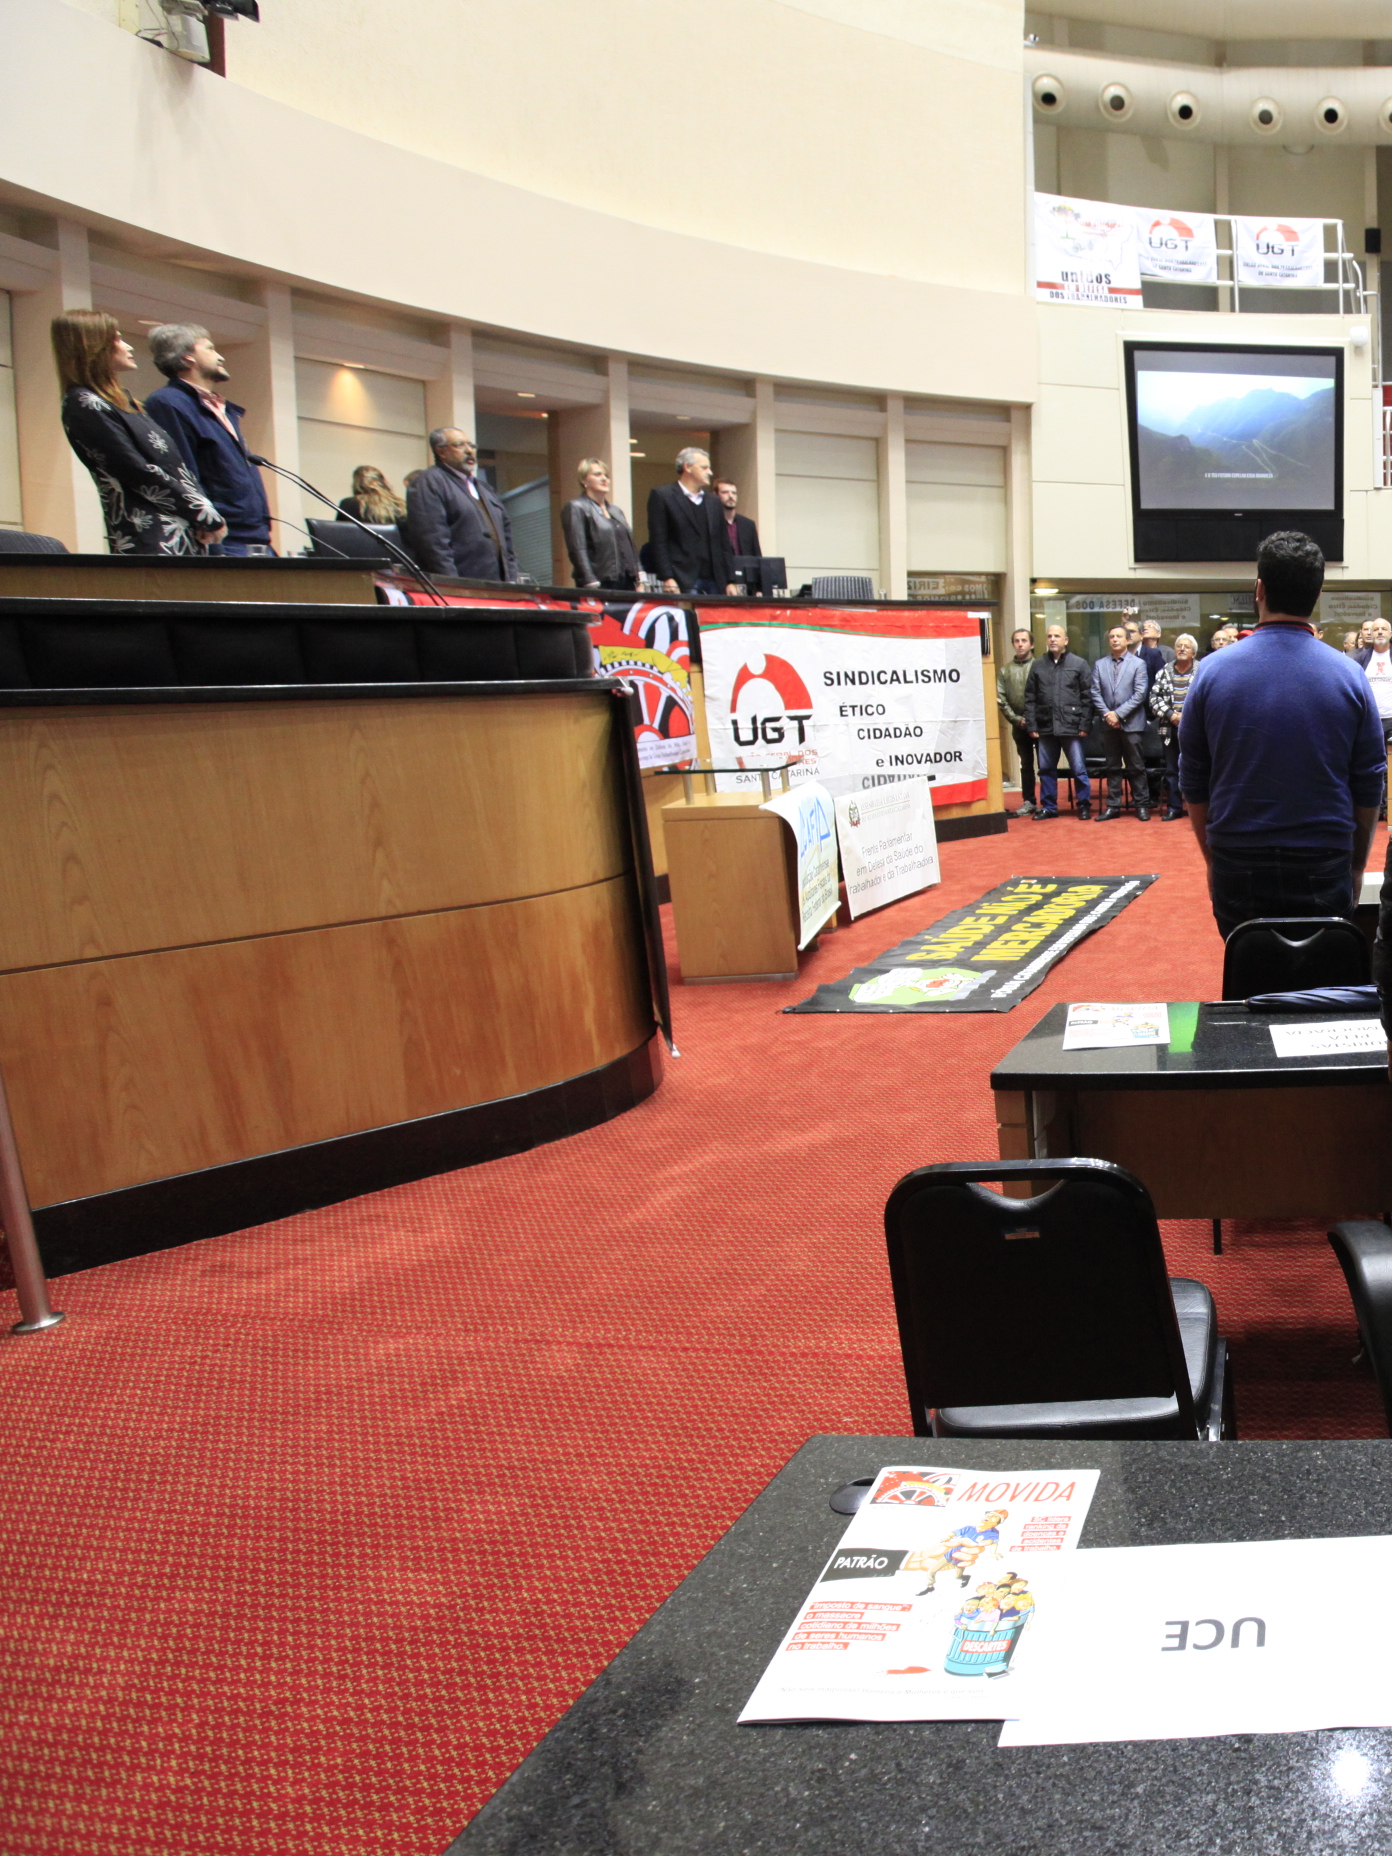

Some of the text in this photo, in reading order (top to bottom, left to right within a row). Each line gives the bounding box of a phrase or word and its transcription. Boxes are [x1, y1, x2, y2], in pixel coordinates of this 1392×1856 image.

[1148, 236, 1190, 251] UGT
[1256, 241, 1300, 257] UGT
[1049, 290, 1065, 300] DOS
[823, 669, 961, 687] SINDICALISMO
[839, 702, 886, 718] ÉTICO
[730, 713, 813, 747] UGT
[857, 724, 924, 741] CIDADÃO
[875, 750, 963, 768] e INOVADOR
[735, 767, 820, 784] SANT CAARINA
[862, 831, 913, 858] Frente Parlamentar
[856, 844, 924, 877] em Defesa da Saúde do
[887, 869, 895, 880] da
[905, 883, 1058, 960] SAÚDE NÃO É
[970, 884, 1109, 961] MERCADORIA
[1286, 1025, 1379, 1036] MOCRACIA
[956, 1481, 1077, 1503] MOVIDA
[1025, 1523, 1054, 1531] ranking
[1048, 1515, 1069, 1523] lidera
[1023, 1530, 1056, 1538] doenças
[1024, 1544, 1058, 1552] trabalho.
[833, 1554, 889, 1570] PATRÃO
[853, 1602, 865, 1610] de
[800, 1622, 897, 1631] cotidiano de milhões
[1161, 1616, 1266, 1652] UCE
[794, 1632, 883, 1640] de seres humanos
[803, 1642, 845, 1650] trabalho.
[963, 1640, 1007, 1652] DESCARTES
